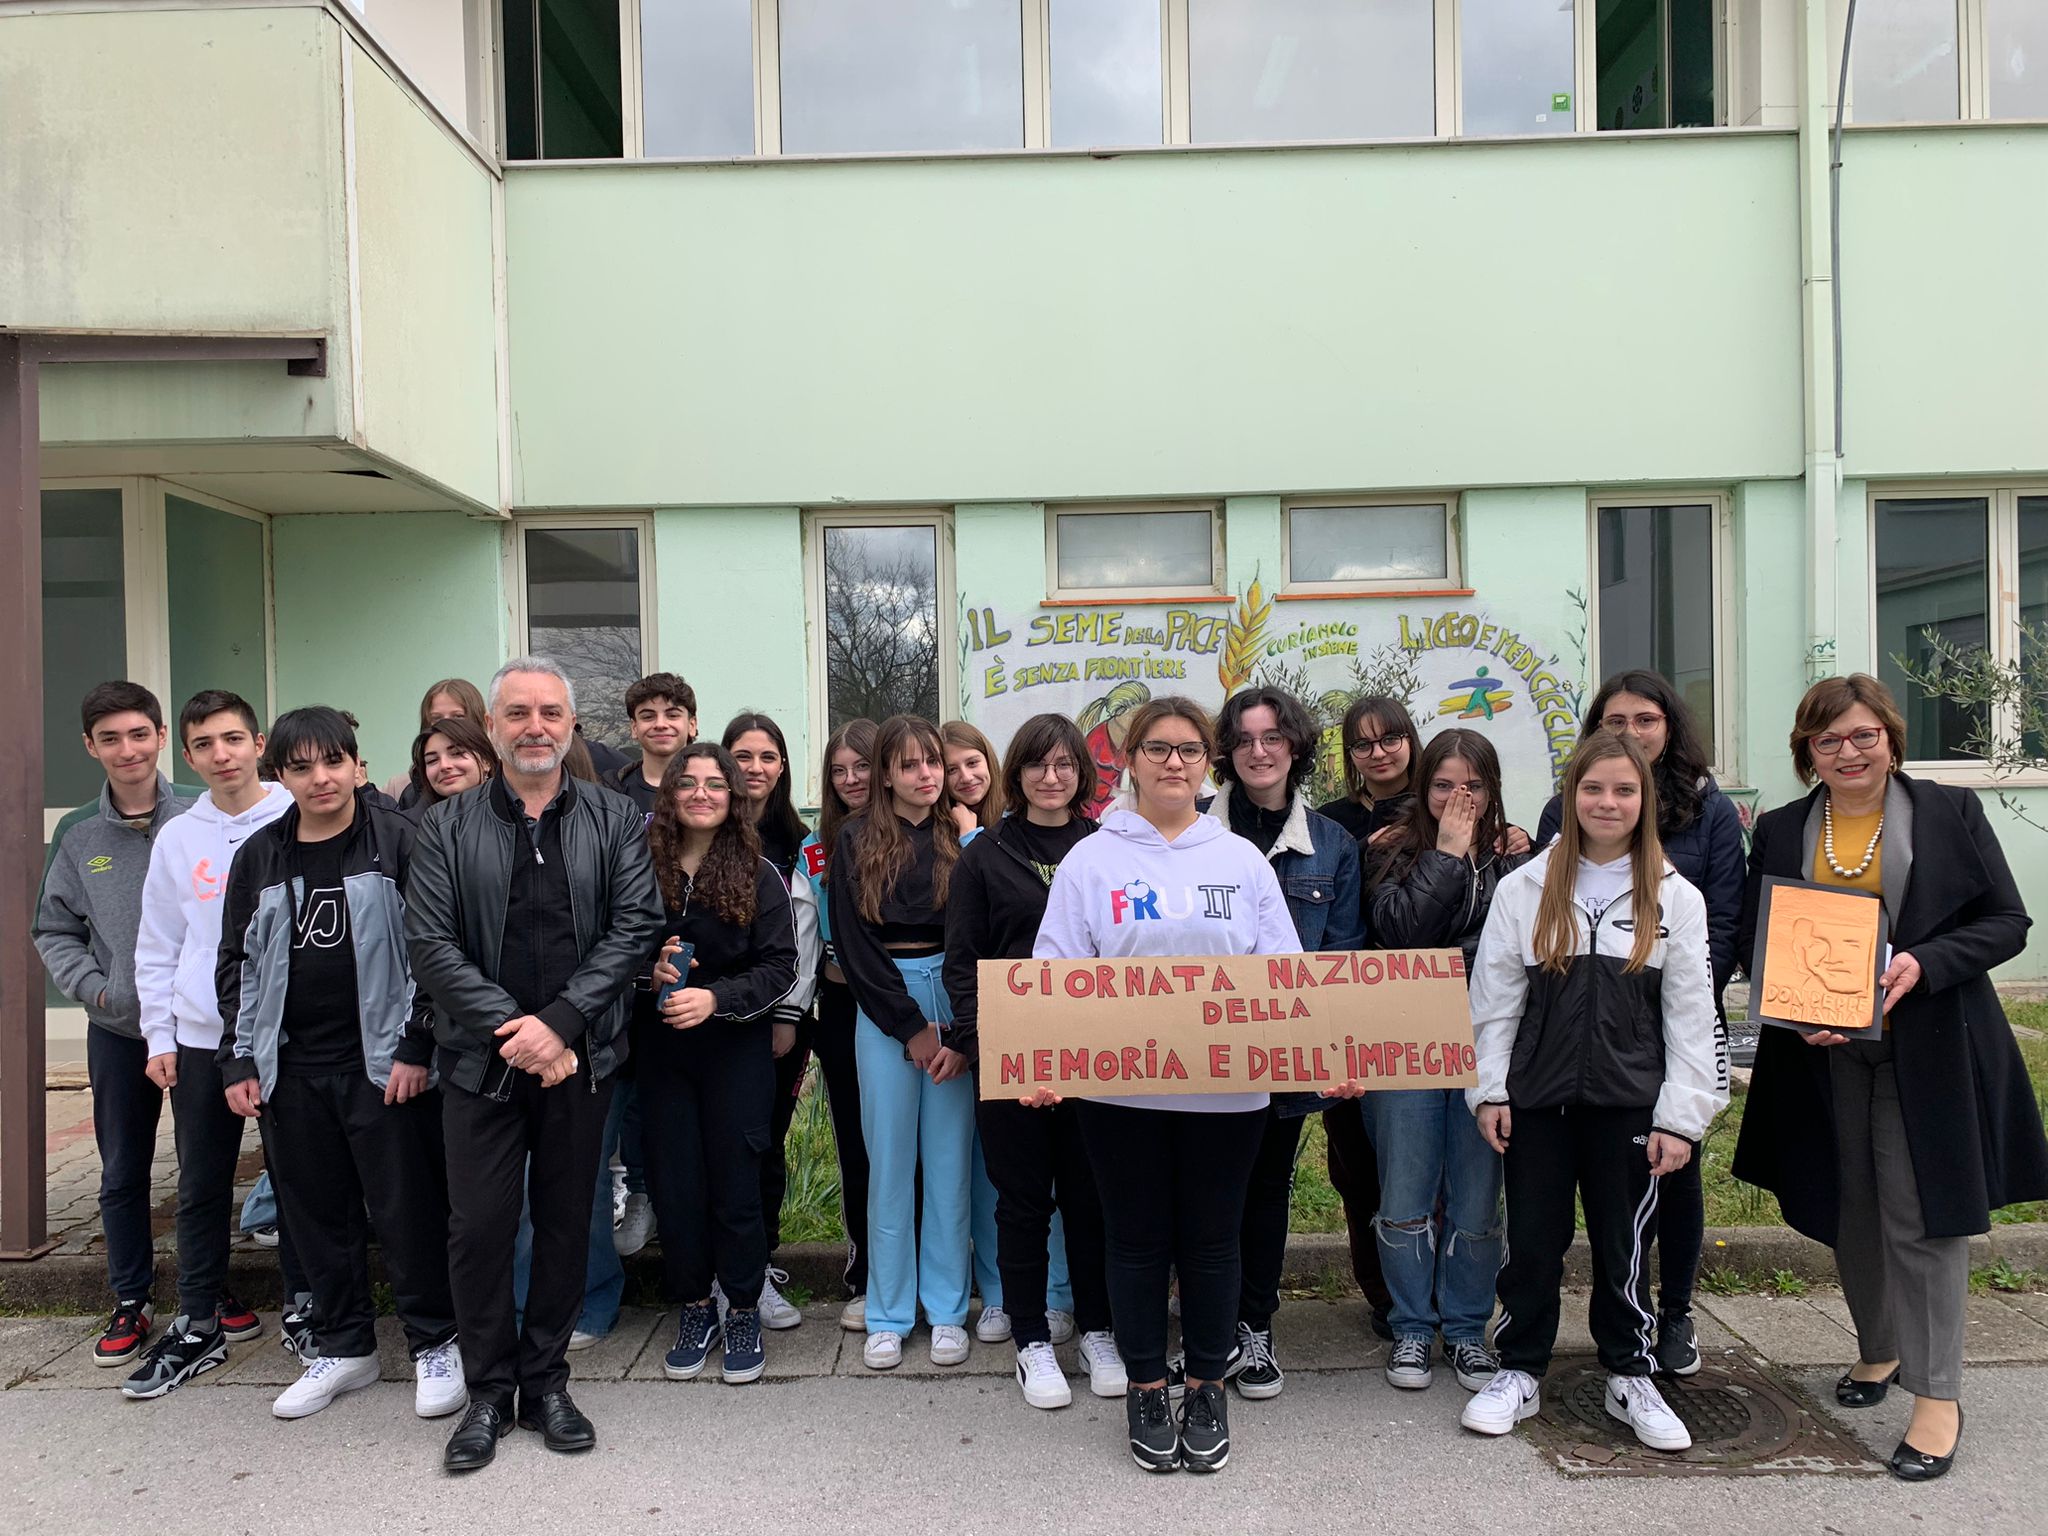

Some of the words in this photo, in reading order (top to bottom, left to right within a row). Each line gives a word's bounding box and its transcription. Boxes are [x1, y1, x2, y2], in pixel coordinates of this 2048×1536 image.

[967, 608, 1012, 651] IL
[1026, 612, 1124, 647] SEME
[1162, 610, 1228, 653] PACE
[1398, 611, 1480, 650] LICEO
[984, 655, 1008, 698] È
[1013, 662, 1080, 693] SENZA
[1202, 997, 1311, 1025] DELLA
[1208, 1045, 1231, 1078] E
